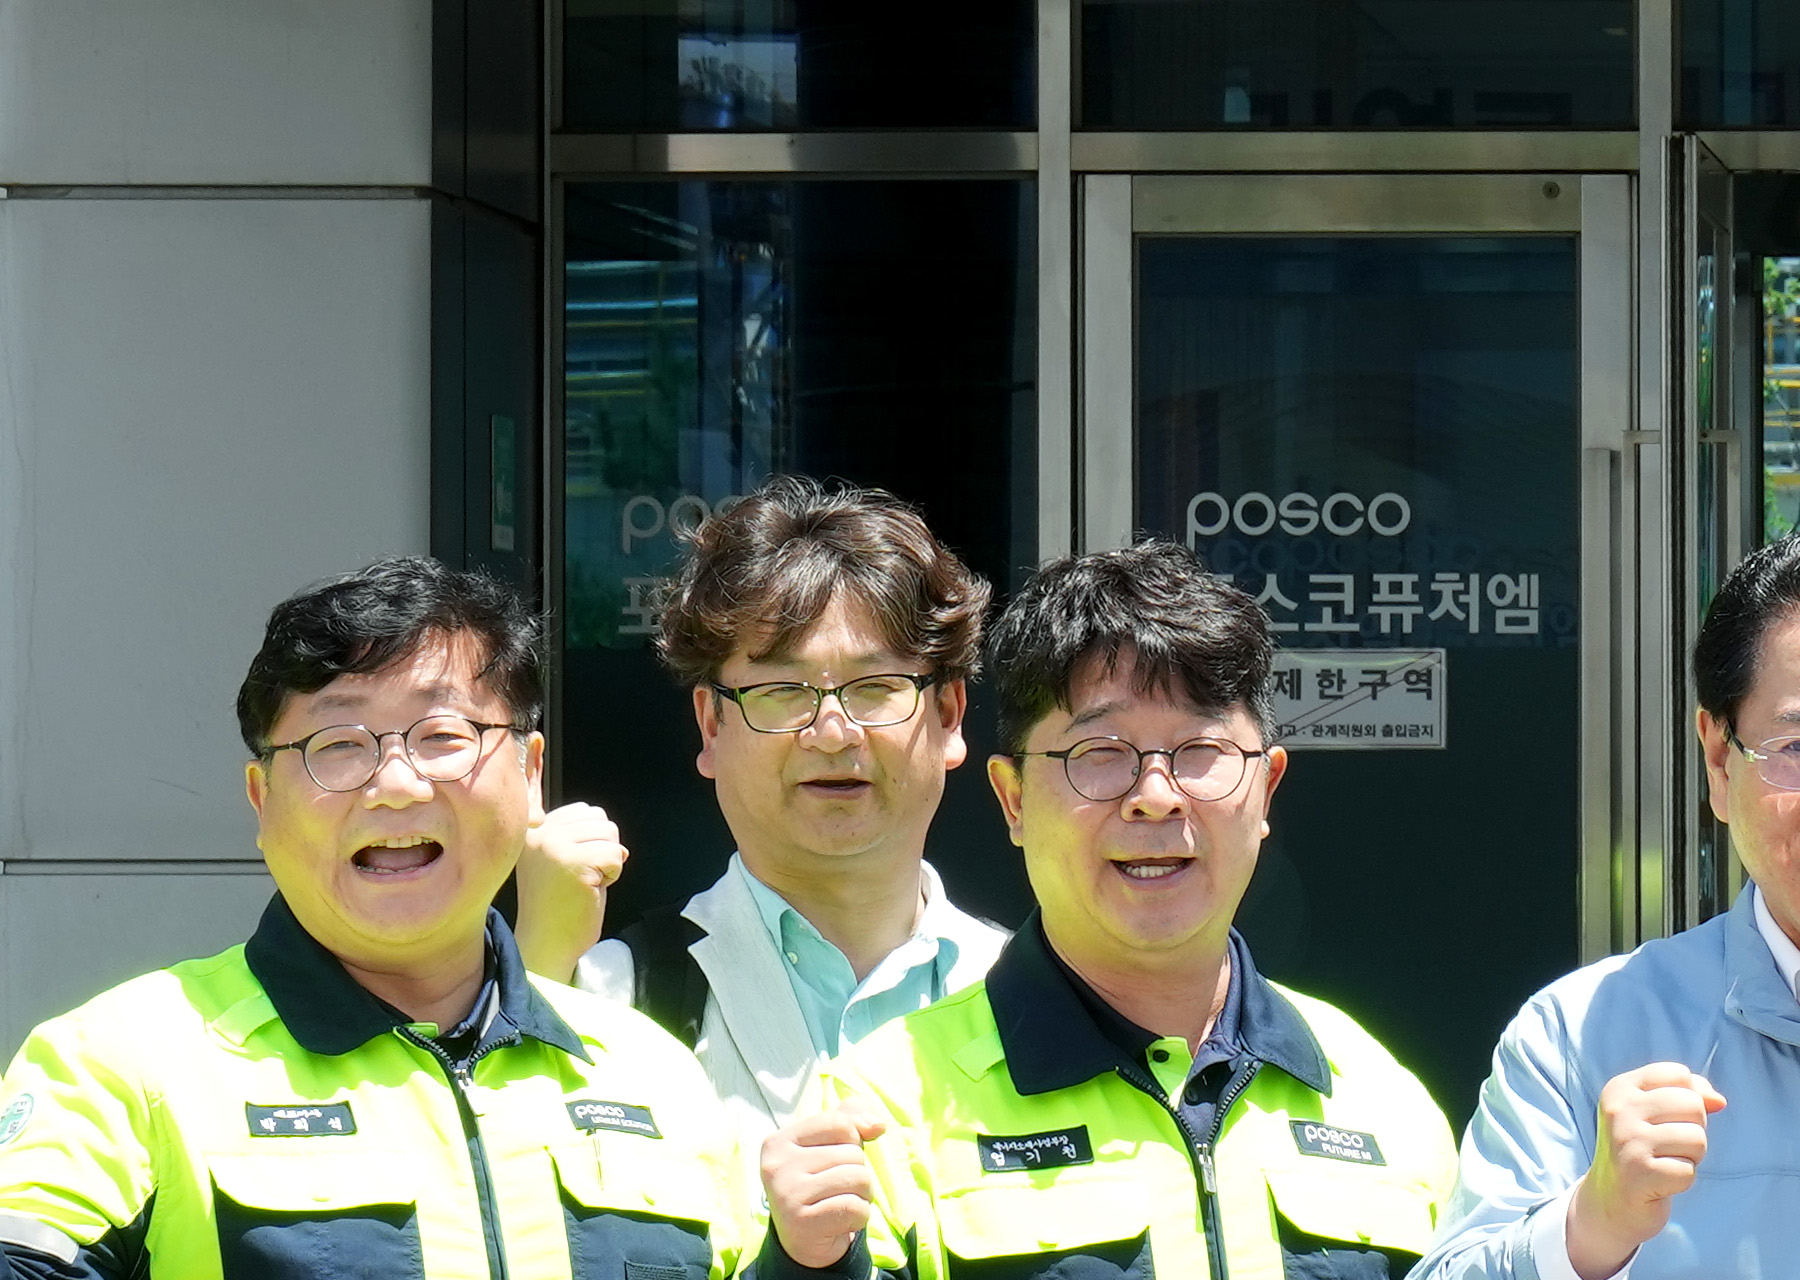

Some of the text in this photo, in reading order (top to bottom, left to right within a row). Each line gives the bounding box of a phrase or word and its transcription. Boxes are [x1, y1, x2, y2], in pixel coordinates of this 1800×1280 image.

[1186, 492, 1412, 551] posco
[1212, 572, 1541, 635] 스코퓨처엠
[1312, 724, 1376, 738] 관계직원외
[1382, 724, 1434, 738] 출입금지
[574, 1104, 626, 1120] posco
[1304, 1124, 1365, 1149] posco
[1321, 1142, 1362, 1160] FUTURE
